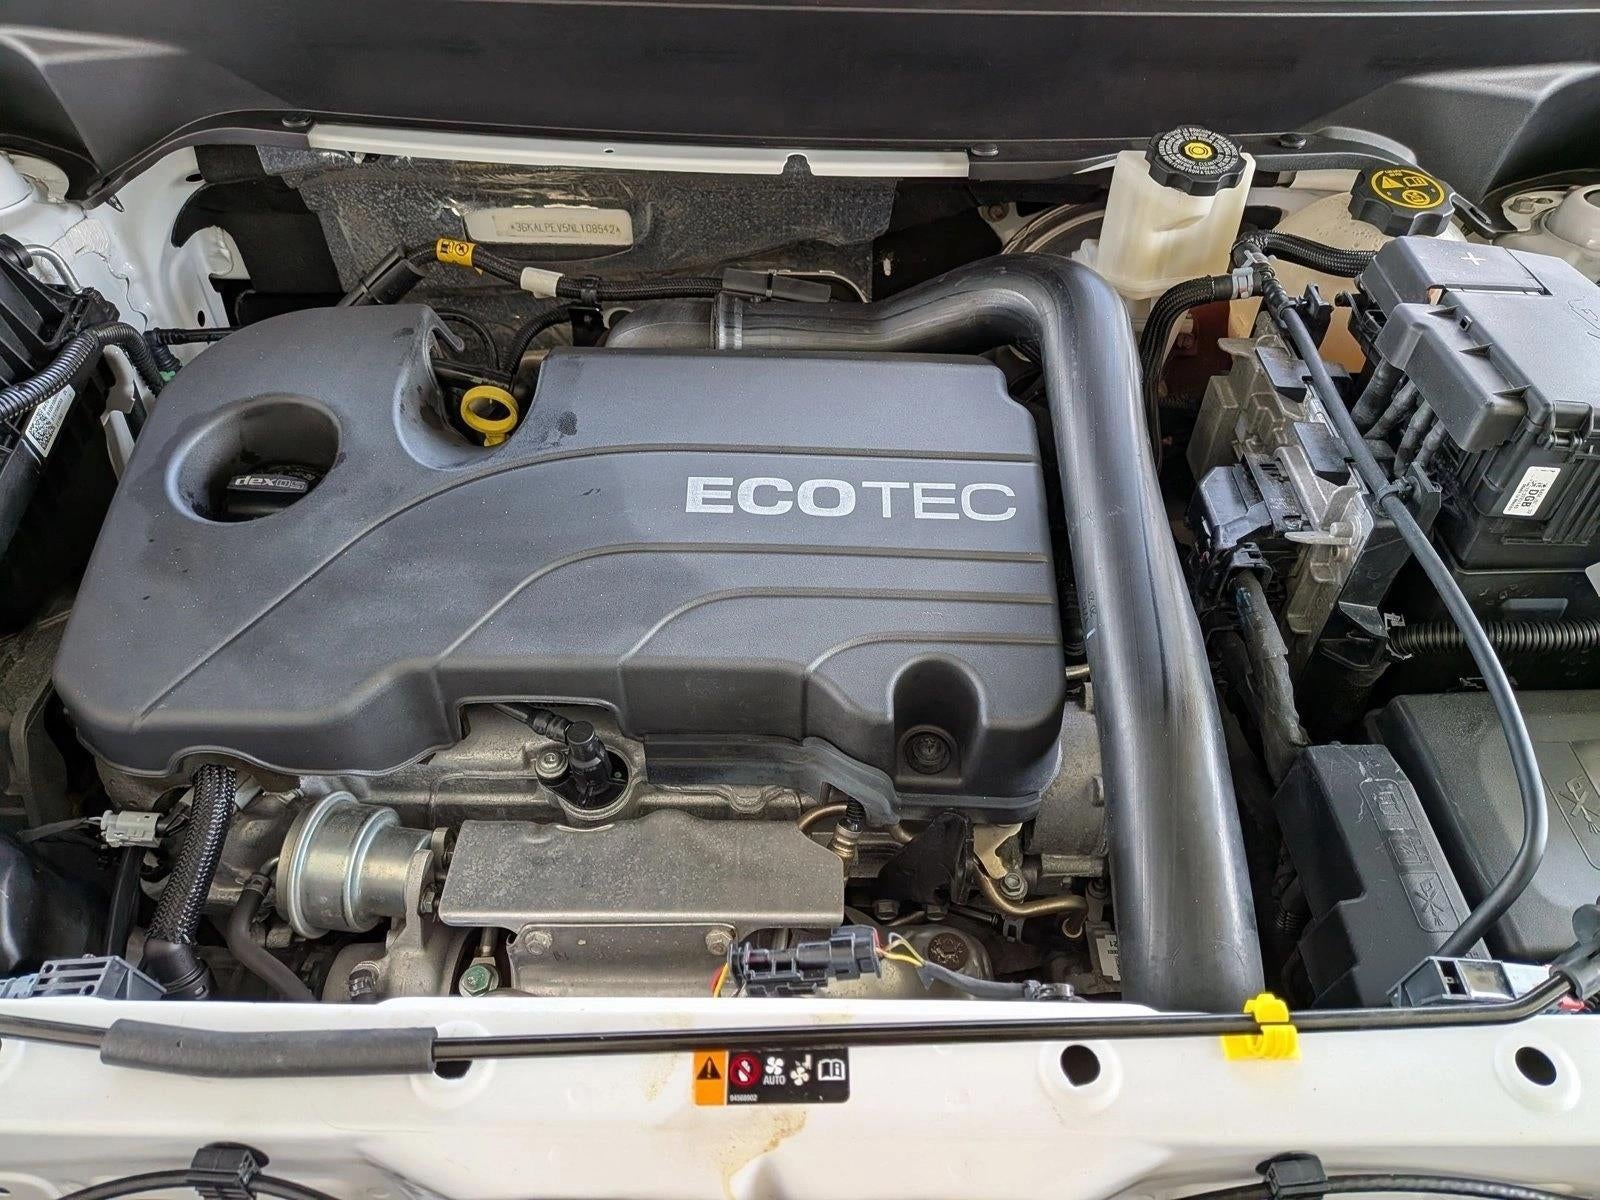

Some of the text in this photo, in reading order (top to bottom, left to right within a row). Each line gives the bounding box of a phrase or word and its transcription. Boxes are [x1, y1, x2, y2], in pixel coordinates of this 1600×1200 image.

[235, 475, 306, 490] dexos
[685, 476, 1017, 521] ECOTEC
[1521, 489, 1540, 507] DGB
[763, 1075, 786, 1085] AUTO
